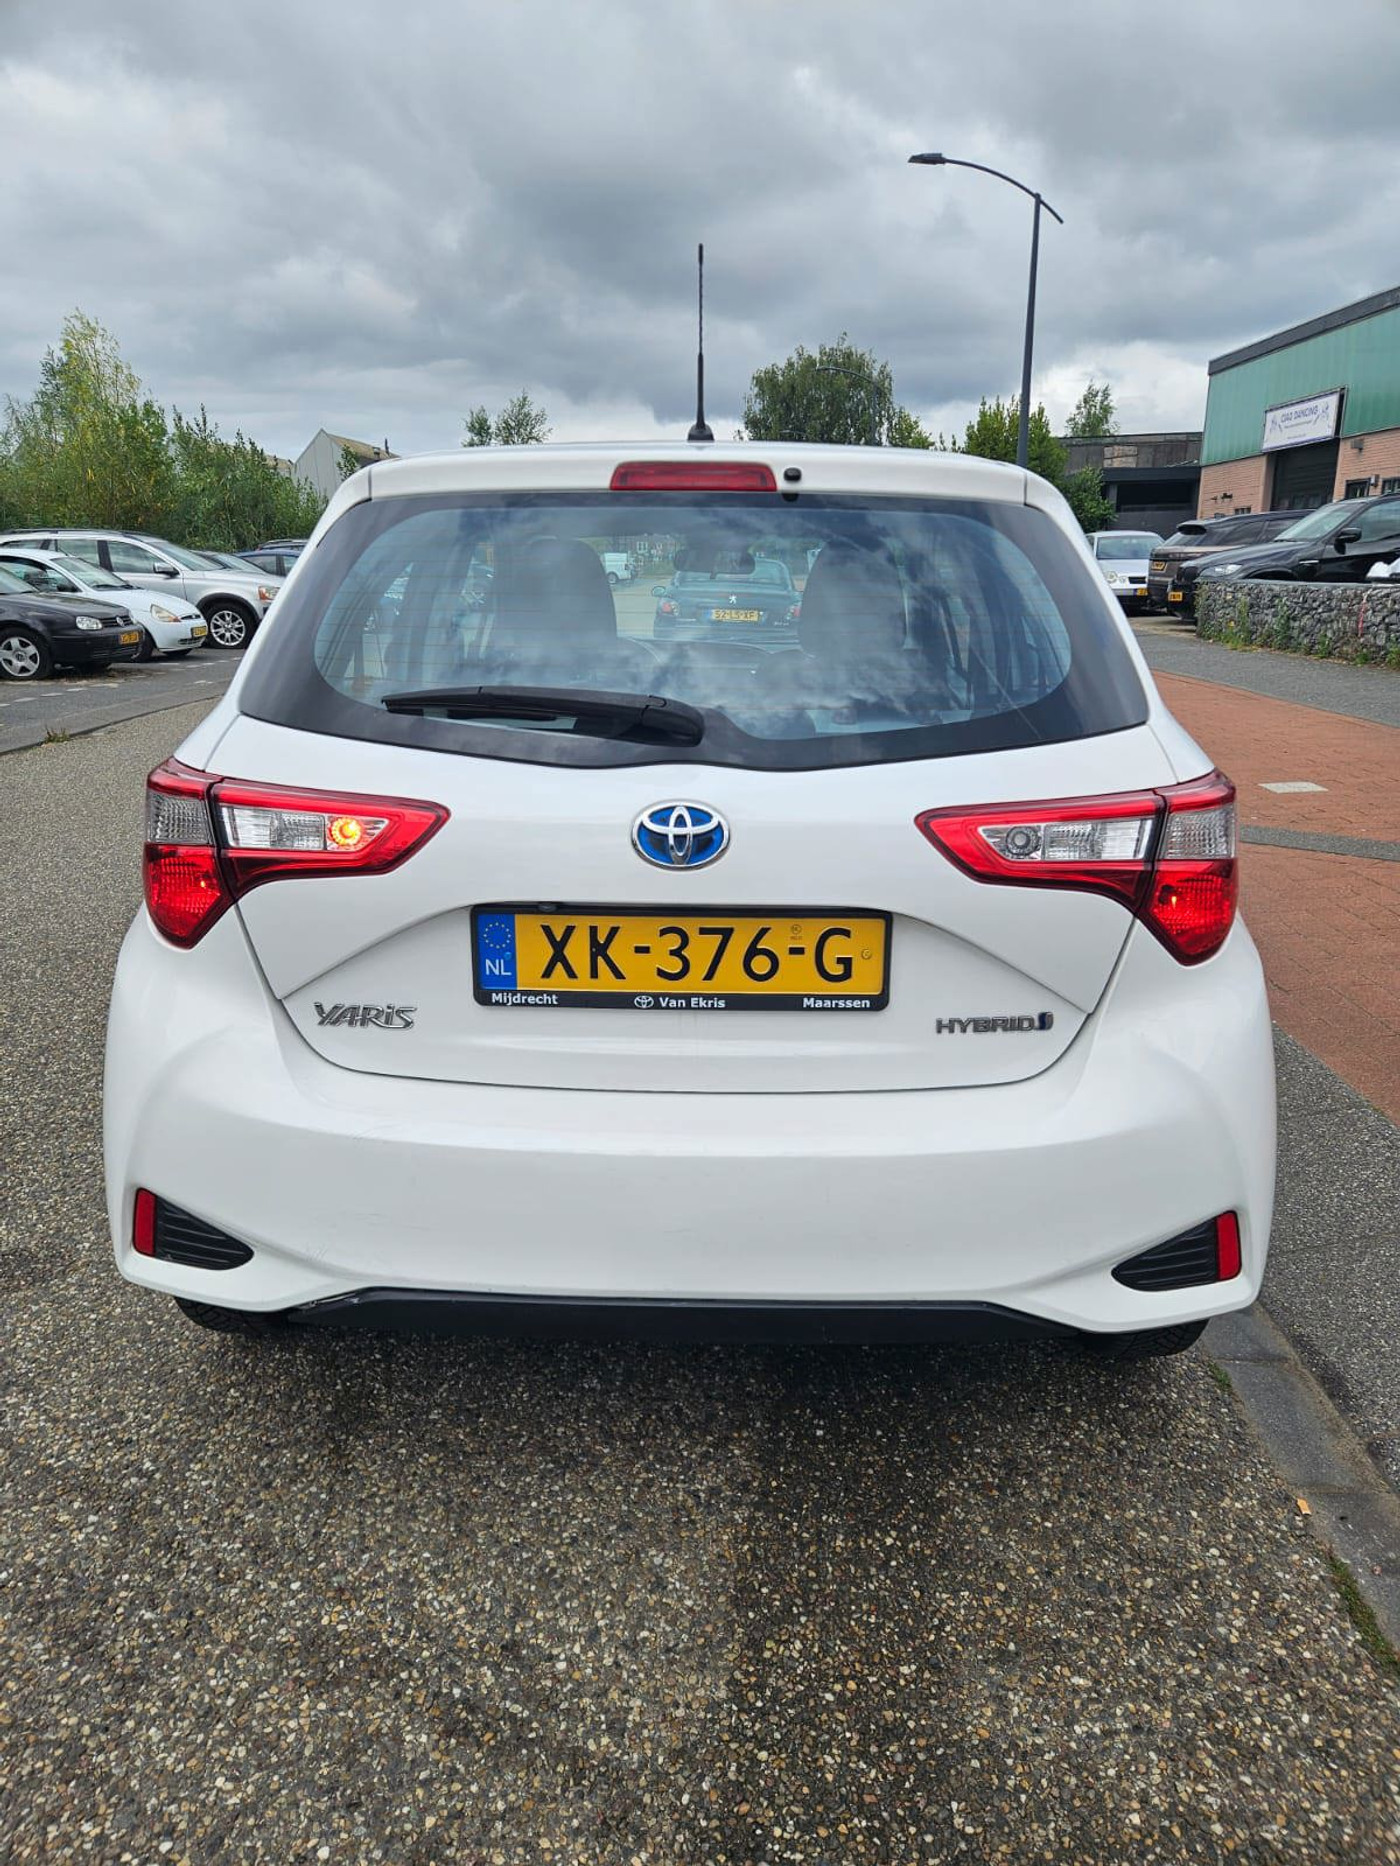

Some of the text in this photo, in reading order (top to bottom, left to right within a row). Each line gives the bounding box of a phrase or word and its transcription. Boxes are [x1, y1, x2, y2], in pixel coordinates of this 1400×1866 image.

[540, 924, 853, 982] XK-376-G
[485, 958, 512, 976] NL
[491, 992, 559, 1006] Mijdrecht
[659, 997, 726, 1008] Van Ekris
[802, 997, 871, 1008] Maarssen
[935, 1015, 1035, 1034] HYBRID
